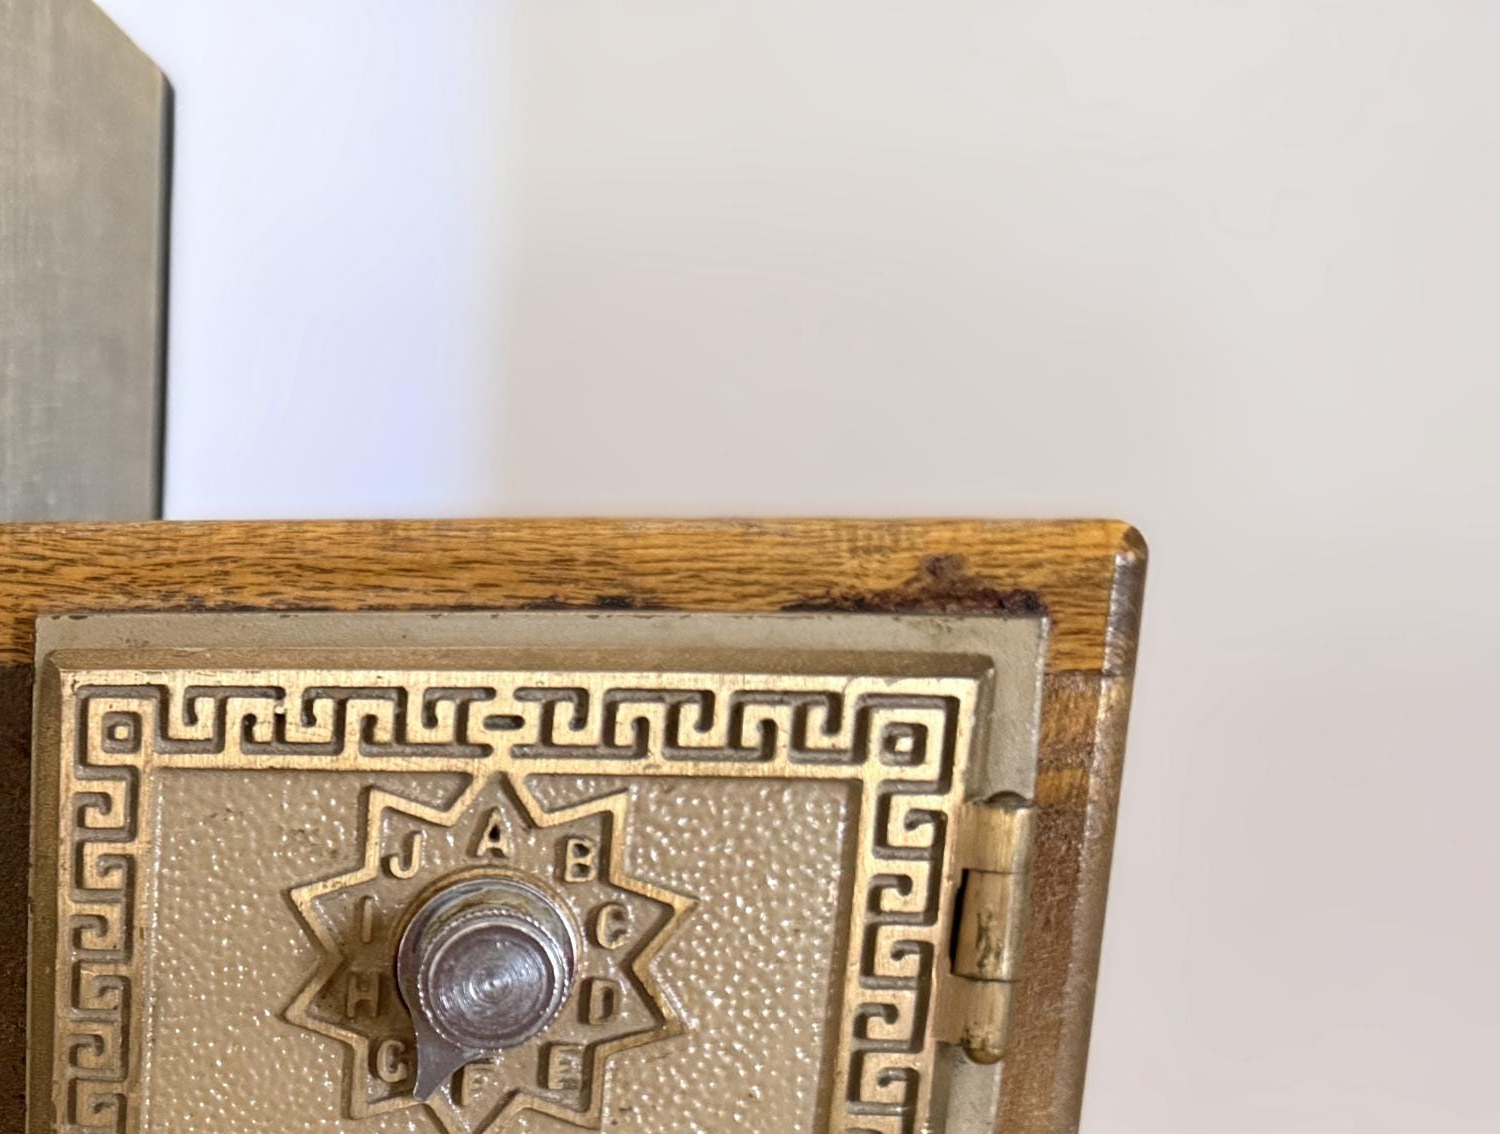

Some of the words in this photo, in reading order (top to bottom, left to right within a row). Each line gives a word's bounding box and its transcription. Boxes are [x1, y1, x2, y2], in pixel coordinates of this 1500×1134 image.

[389, 831, 421, 879] J
[477, 811, 509, 858] A
[565, 837, 597, 883] B
[360, 896, 374, 943] I
[596, 904, 628, 951] C
[347, 971, 380, 1018] H
[588, 978, 619, 1025] D
[461, 1062, 496, 1107] F
[548, 1046, 584, 1091] E
